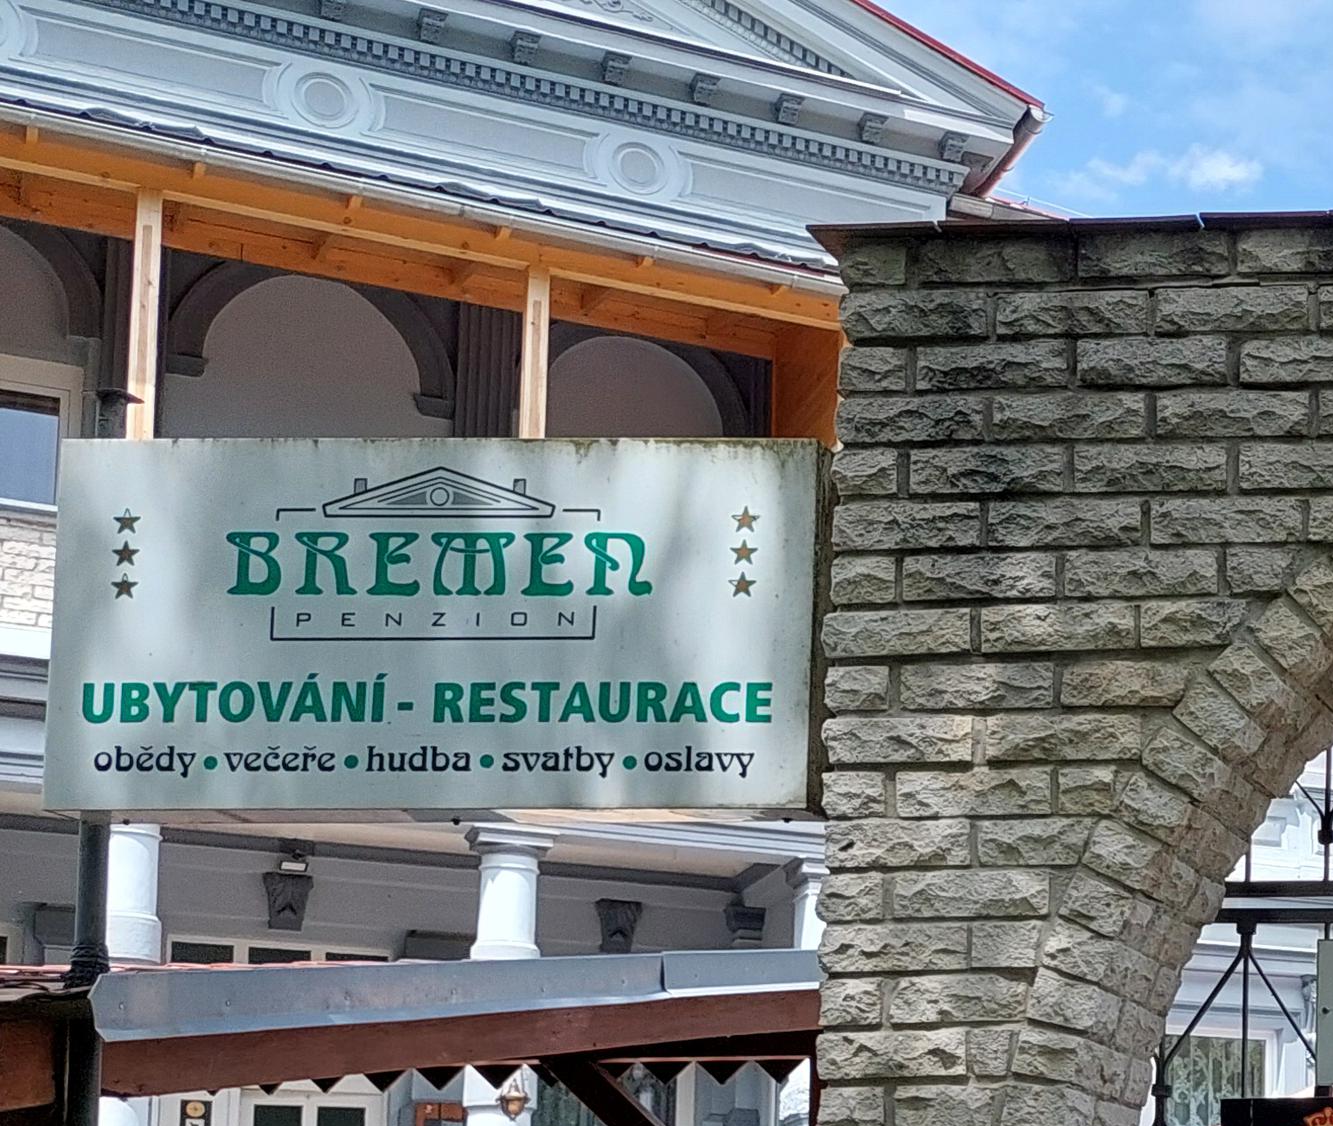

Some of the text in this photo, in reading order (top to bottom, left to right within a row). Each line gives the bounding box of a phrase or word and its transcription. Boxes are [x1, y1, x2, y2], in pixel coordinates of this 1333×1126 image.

[226, 531, 653, 597] BREMEN
[295, 611, 577, 628] PENZION
[81, 673, 387, 724] UBYTOVÁNÍ
[432, 681, 773, 723] RESTAURACE
[93, 742, 755, 779] obědy večeře hudba svatby oslavy
